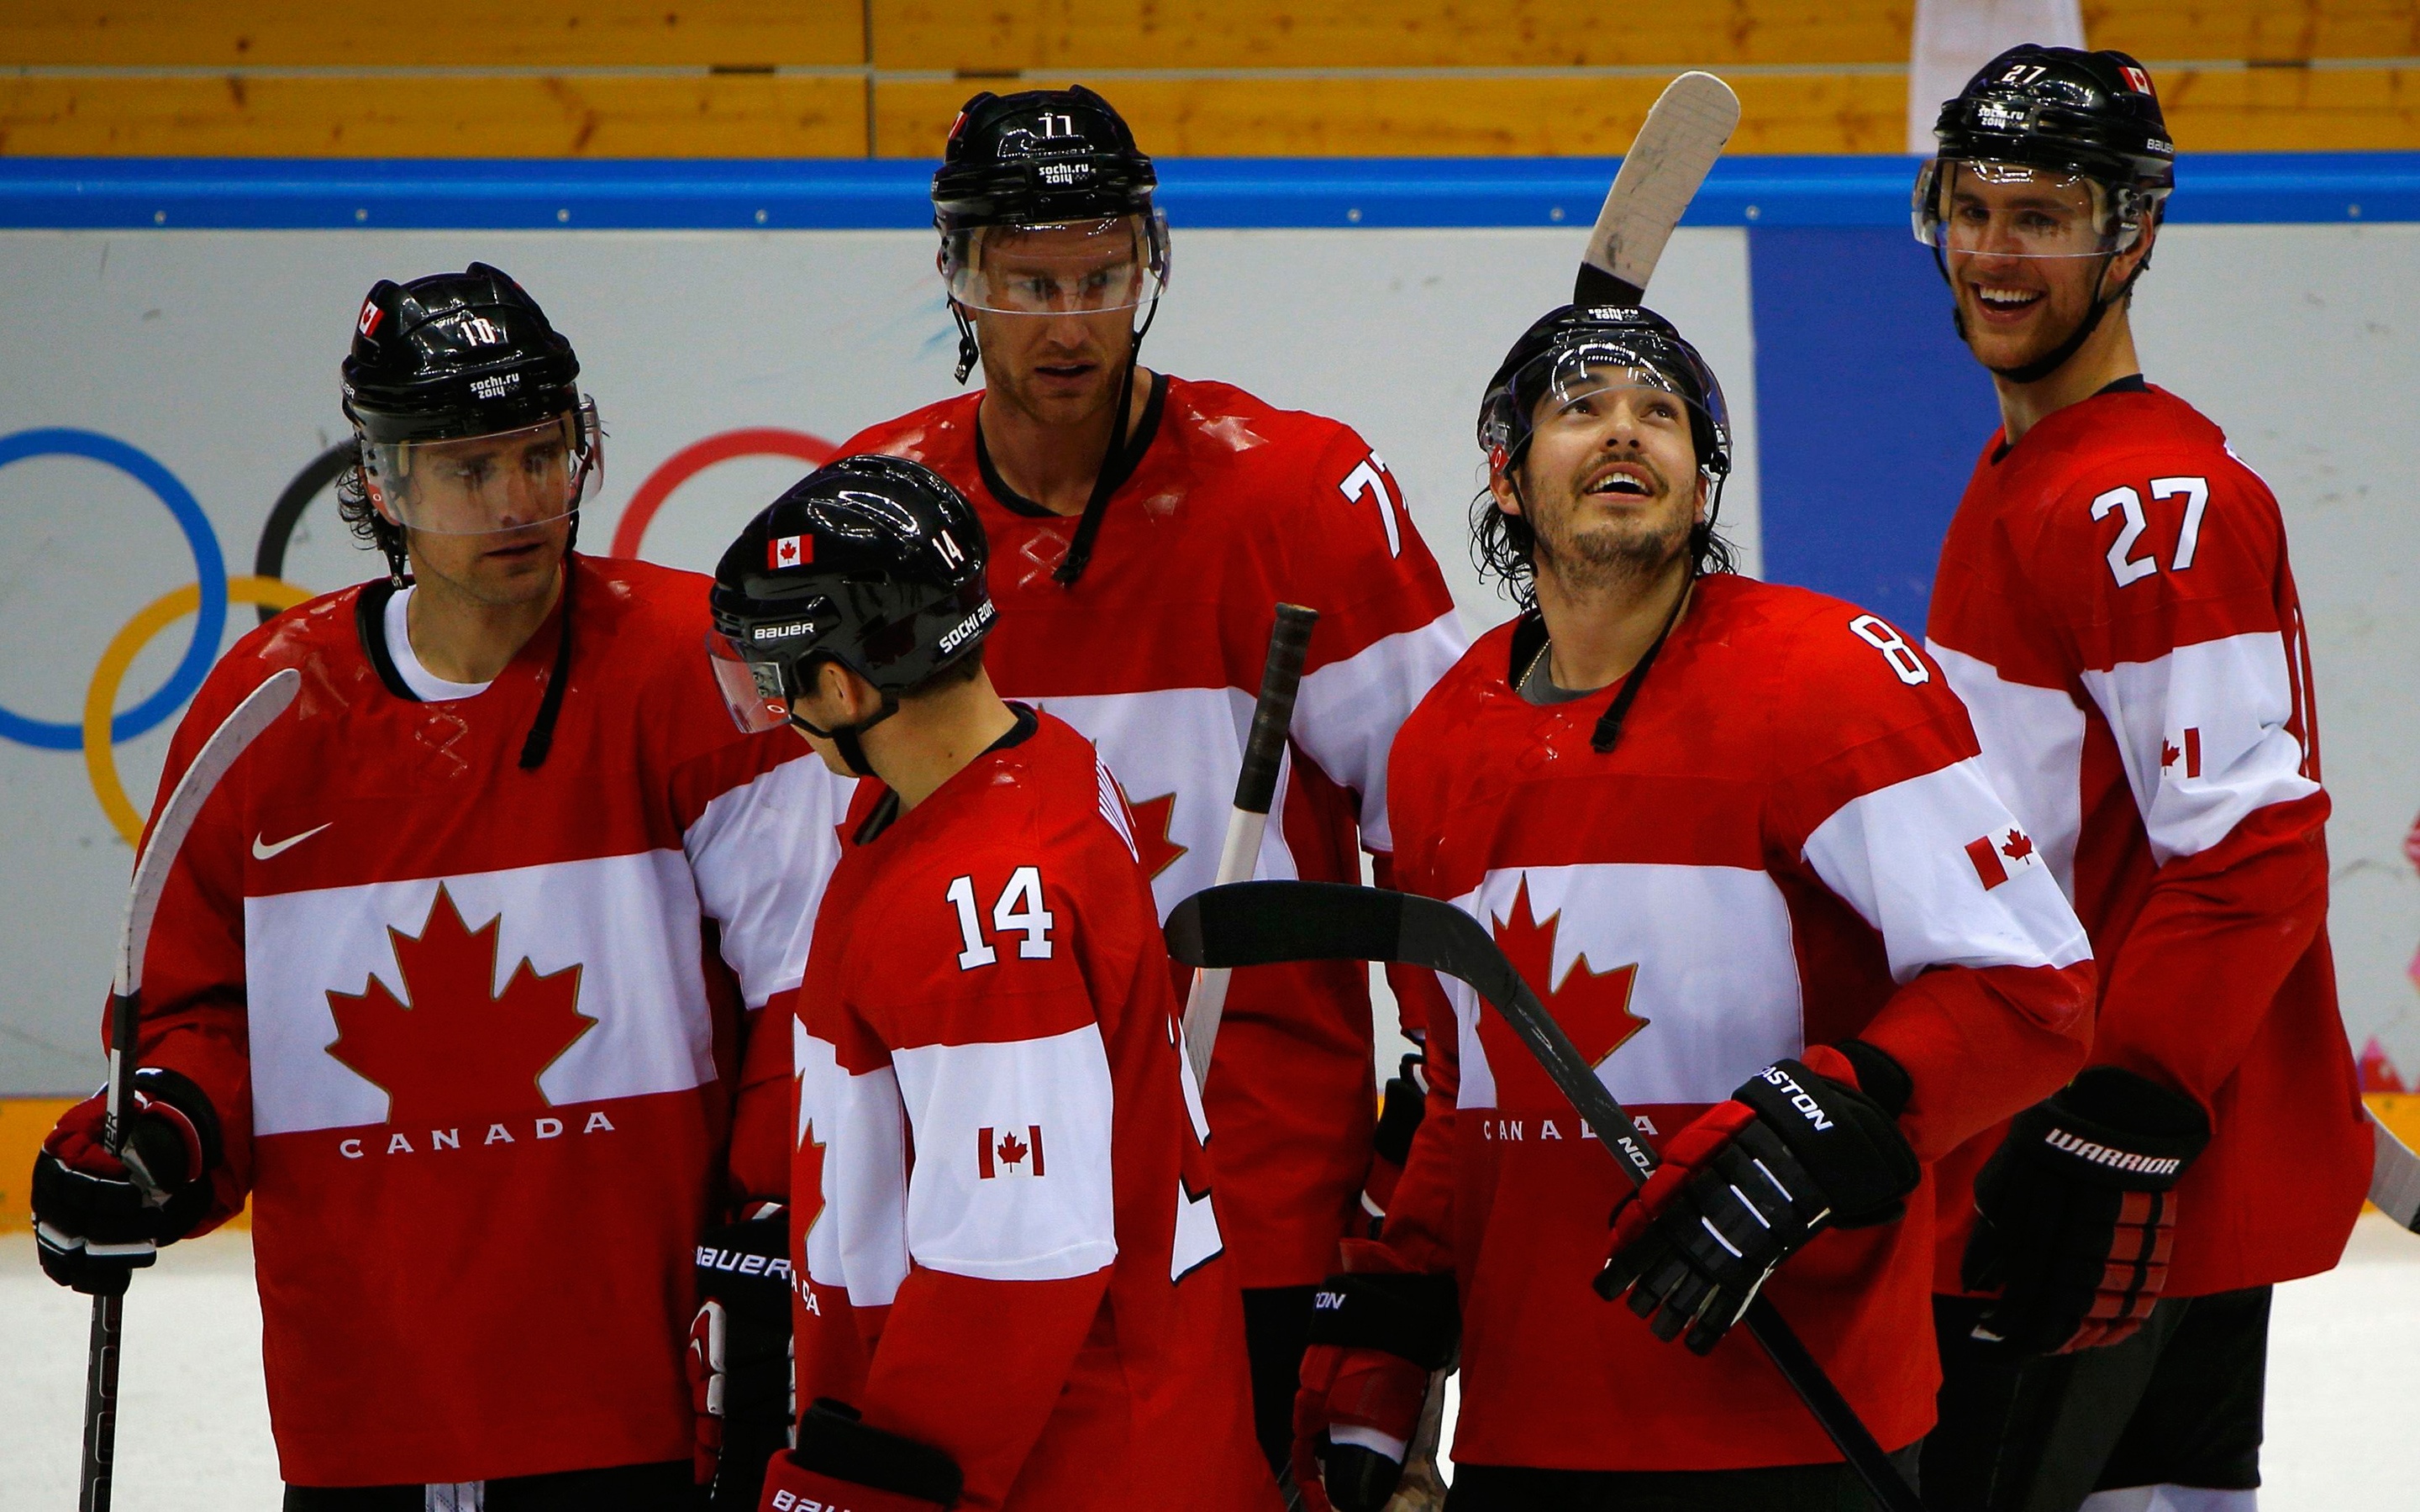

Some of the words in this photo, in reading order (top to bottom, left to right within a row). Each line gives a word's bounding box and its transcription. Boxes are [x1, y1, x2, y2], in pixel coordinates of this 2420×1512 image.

[2001, 65, 2047, 83] 27
[1981, 117, 2006, 129] 2014
[1039, 163, 1089, 176] sochi.ru
[1045, 174, 1073, 184] 2014
[470, 373, 519, 392] sochi.ru
[478, 386, 506, 399] 2014
[932, 529, 965, 570] 14
[2090, 476, 2209, 588] 27
[939, 613, 980, 654] SOCHI
[1849, 614, 1930, 685] 8
[946, 865, 1053, 971] 14
[339, 1111, 615, 1159] CANADA
[2045, 1128, 2181, 1175] WARRIOR
